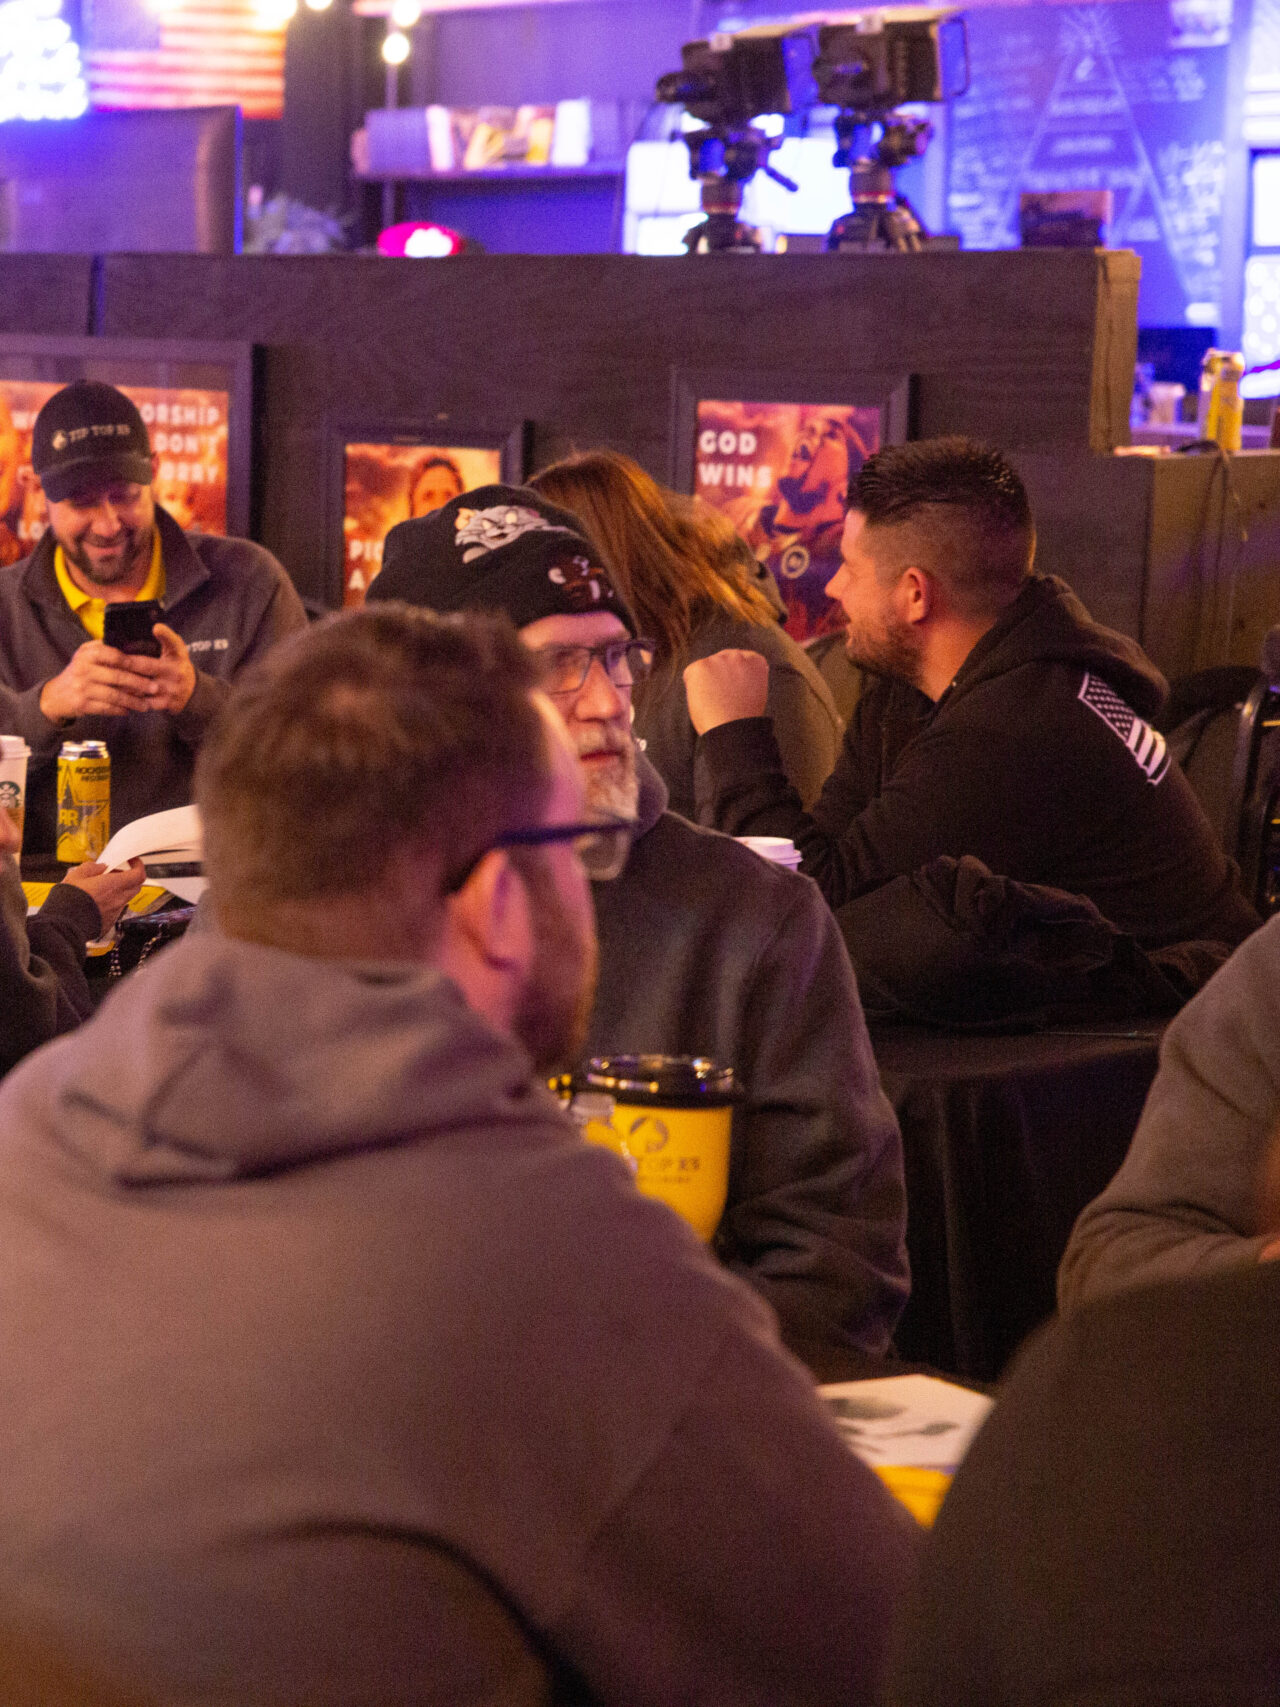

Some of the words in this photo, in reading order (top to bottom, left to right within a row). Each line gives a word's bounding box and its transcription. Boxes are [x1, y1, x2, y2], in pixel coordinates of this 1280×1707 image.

[141, 403, 219, 425] ORSHIP
[700, 430, 757, 455] GOD
[160, 461, 218, 484] ORRY
[699, 463, 773, 487] WINS
